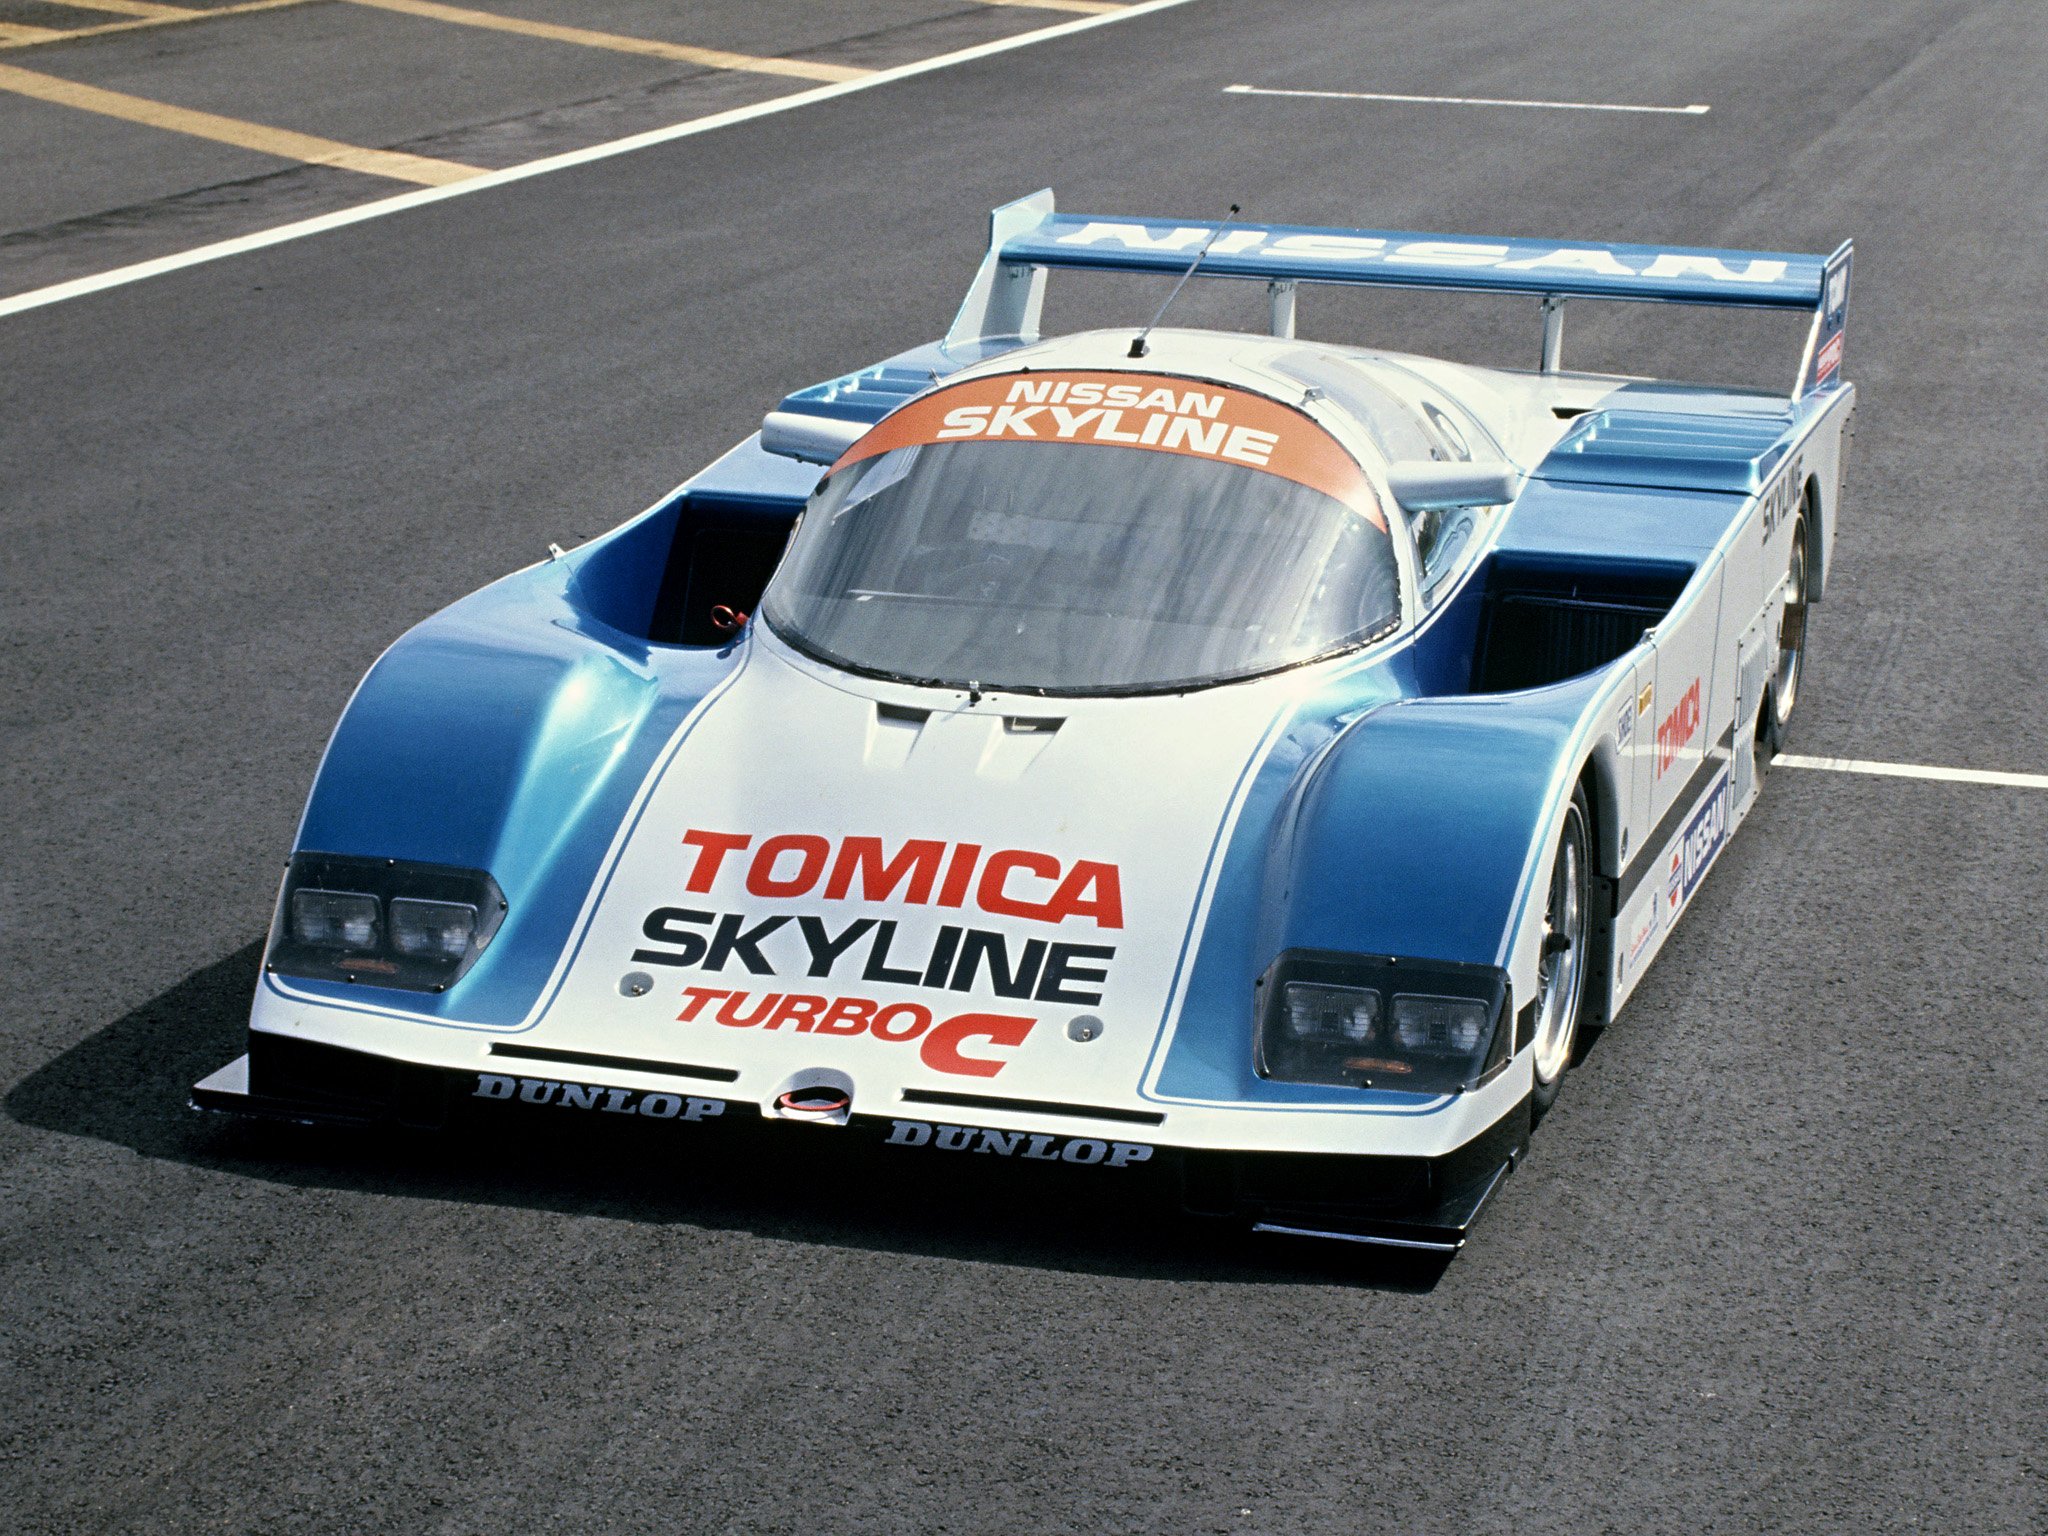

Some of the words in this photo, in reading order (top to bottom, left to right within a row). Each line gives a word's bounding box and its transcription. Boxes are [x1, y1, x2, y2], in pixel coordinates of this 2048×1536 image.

[1056, 222, 1787, 282] NISSAN
[1005, 381, 1226, 418] NISSAN
[936, 405, 1280, 466] SKYLINE
[1657, 676, 1700, 780] TOMICA
[1682, 785, 1727, 889] NISSAN
[681, 829, 1124, 929] TOMICA
[630, 906, 1117, 1006] SKYLINE
[472, 1073, 727, 1122] DUNLOP
[884, 1120, 1154, 1167] DUNLOP
